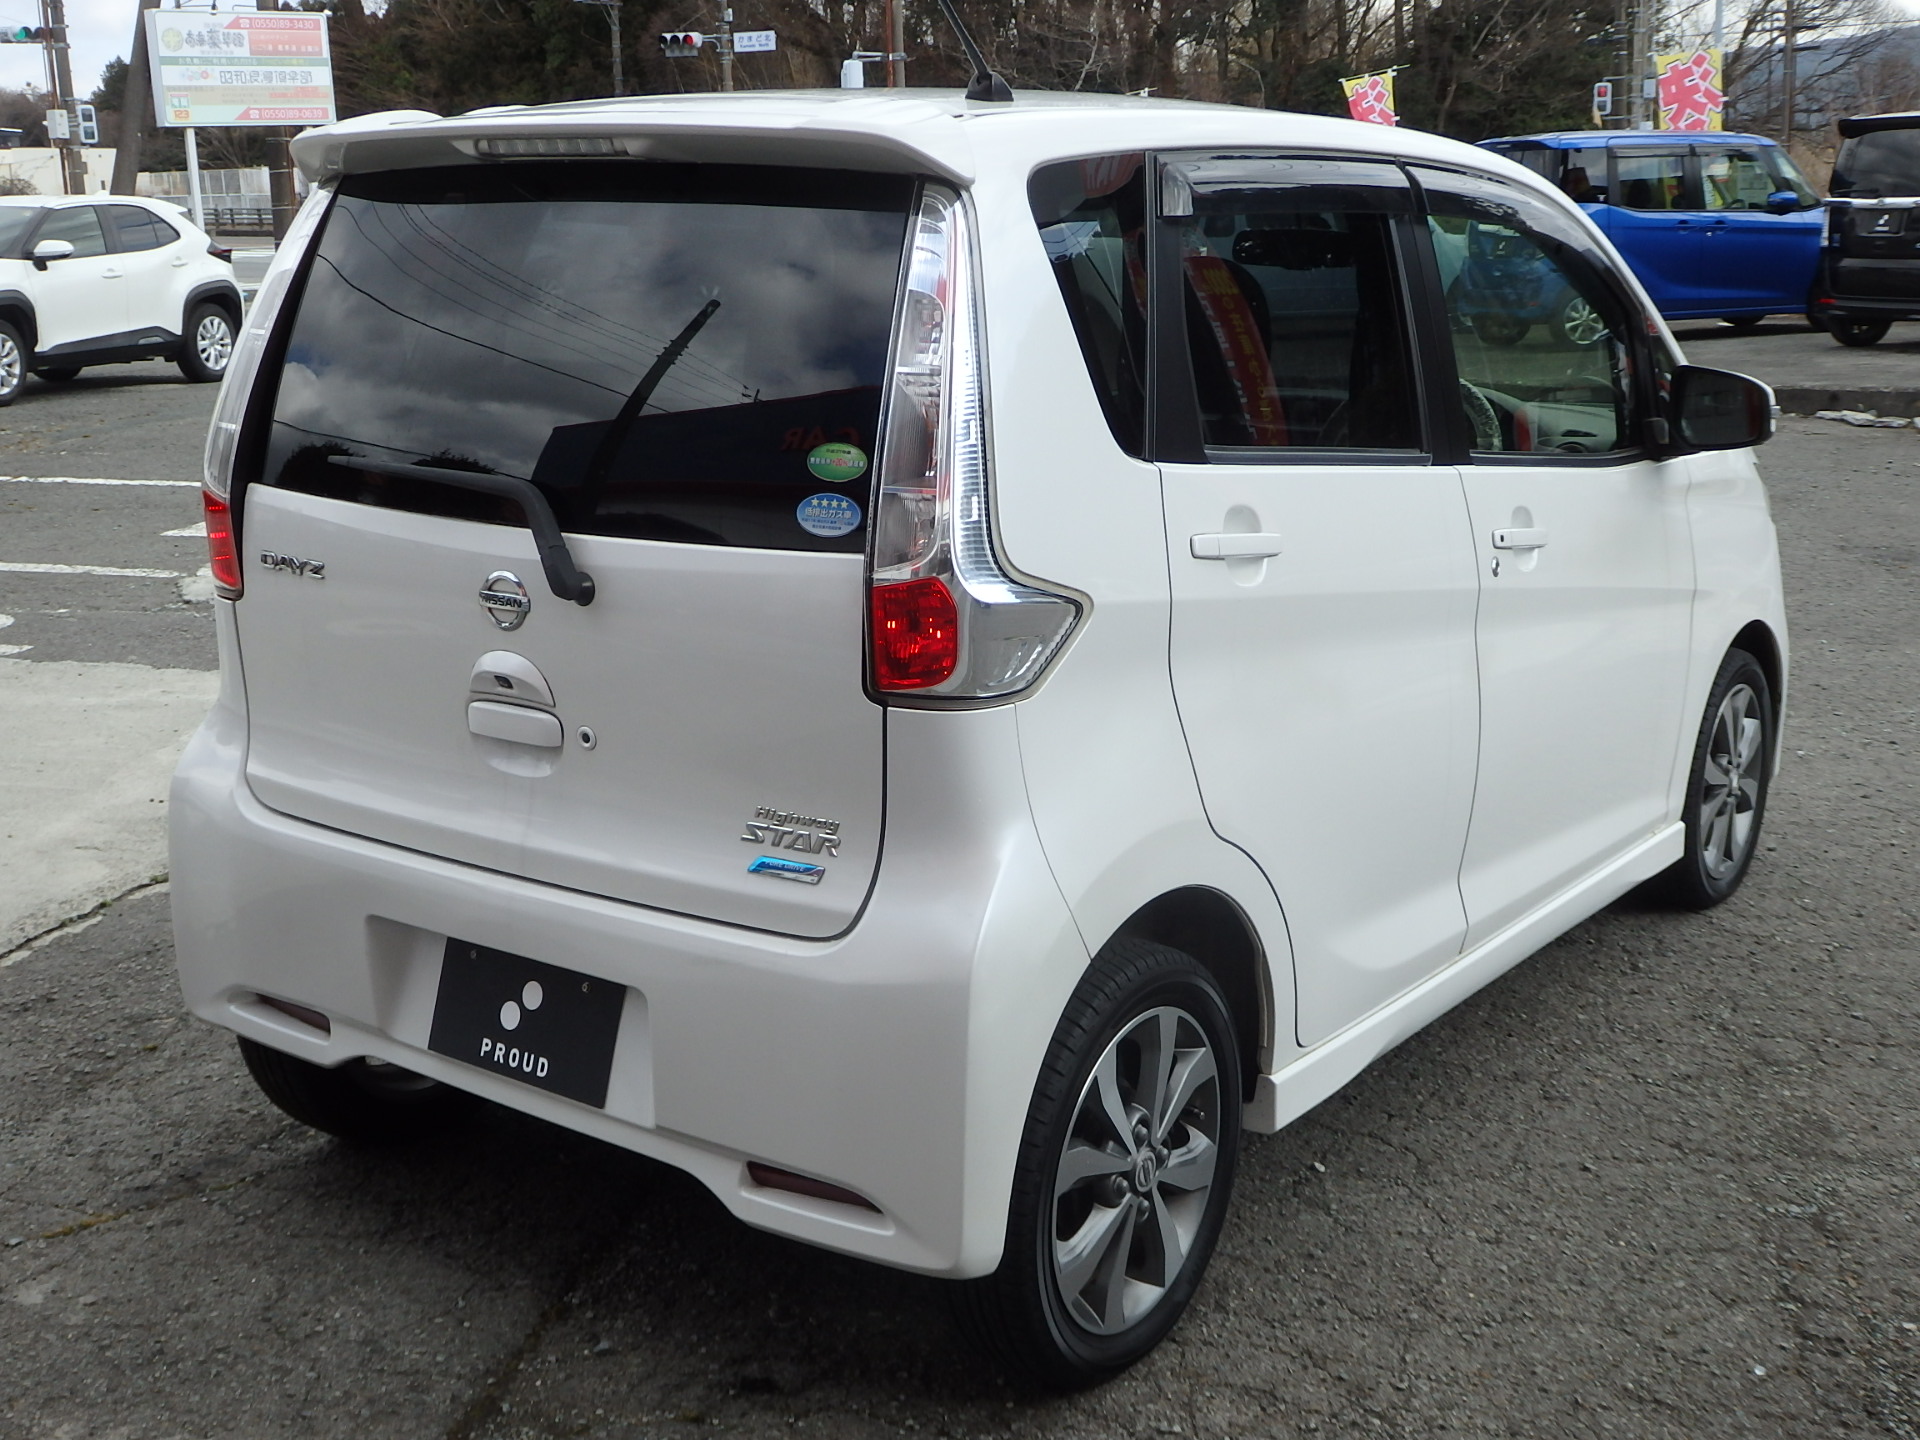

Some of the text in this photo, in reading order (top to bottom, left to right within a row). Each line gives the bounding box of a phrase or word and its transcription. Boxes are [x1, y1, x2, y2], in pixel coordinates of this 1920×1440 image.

[252, 18, 314, 29] (0550)89-3430
[262, 109, 322, 119] (0550)89-0639
[805, 508, 852, 519] 低排出ガス車
[261, 550, 326, 579] DAYZ
[481, 595, 522, 608] NISSAN
[754, 805, 840, 835] Highway
[740, 821, 841, 857] STAR
[480, 1037, 549, 1078] PROUD
